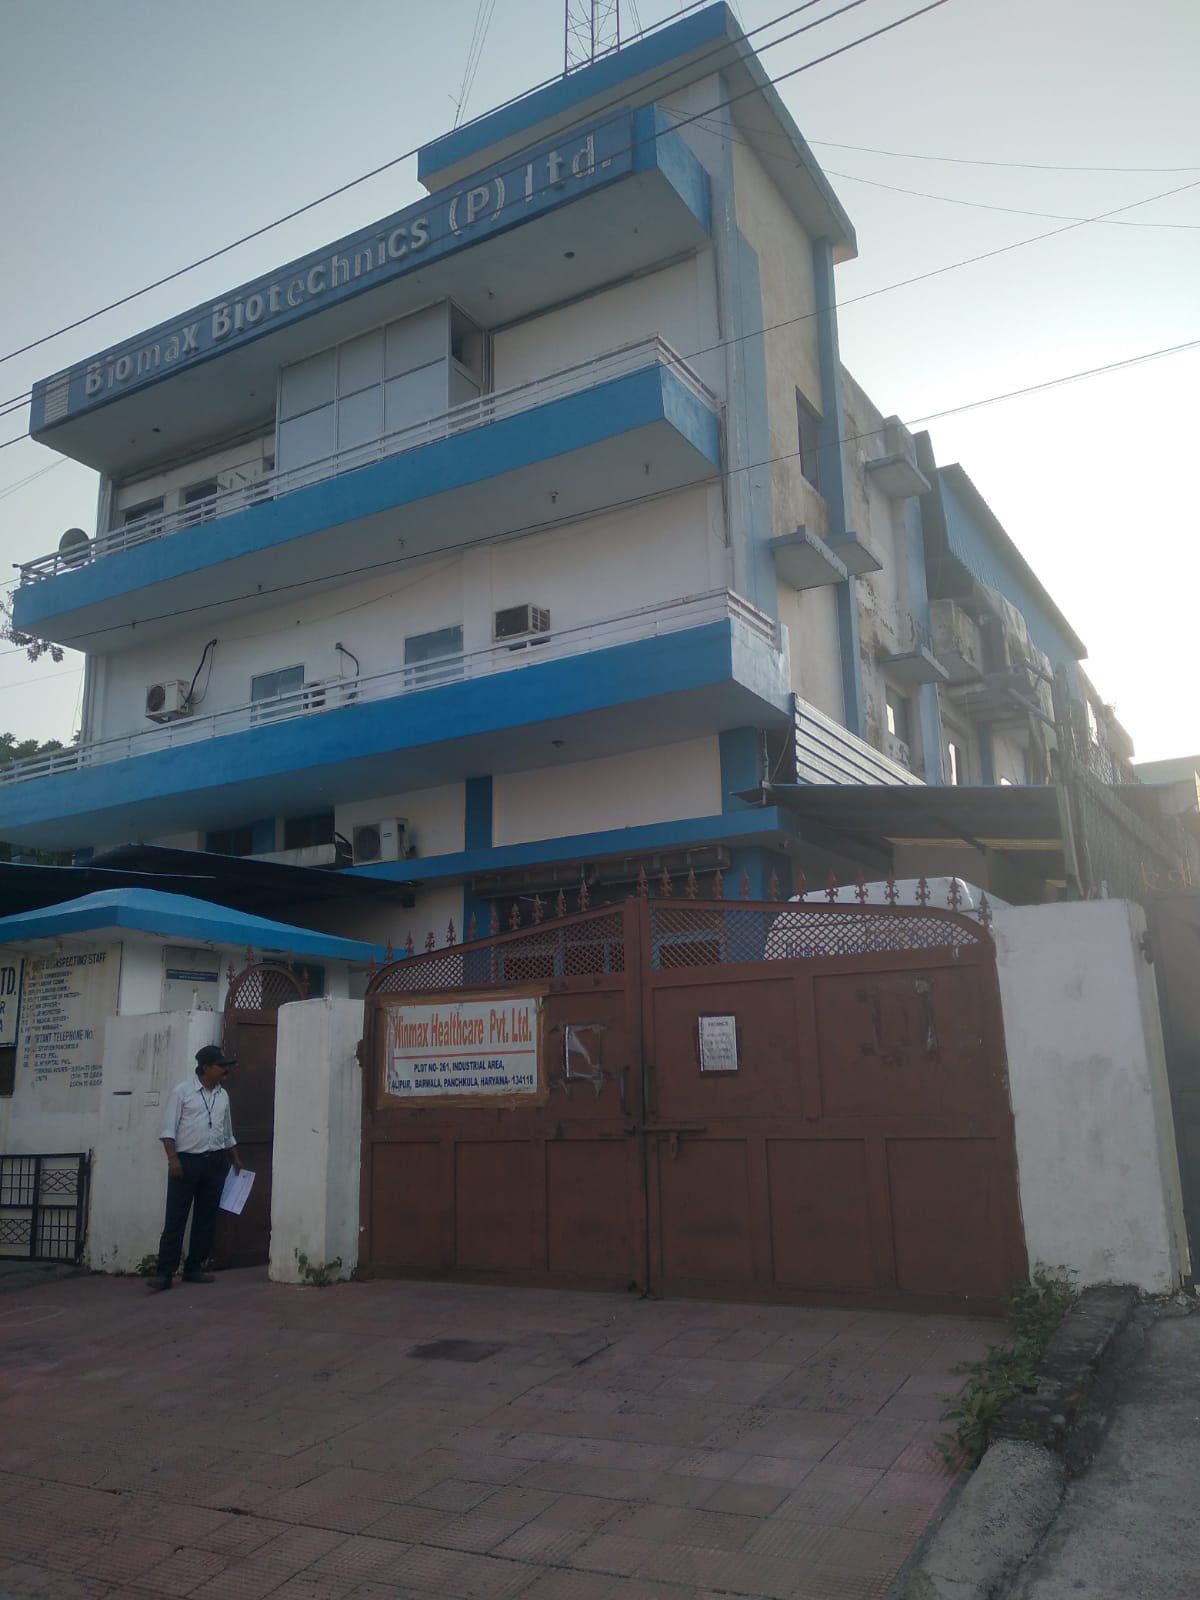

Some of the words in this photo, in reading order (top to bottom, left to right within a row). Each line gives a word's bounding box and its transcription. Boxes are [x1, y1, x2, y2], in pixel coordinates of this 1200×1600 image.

[85, 323, 200, 396] Biomax
[211, 217, 430, 340] Biotechnics
[448, 176, 505, 236] (P)
[88, 952, 107, 965] STAFF
[0, 966, 17, 996] TD.
[431, 1011, 484, 1048] Healthcare
[489, 1008, 509, 1044] Pvt.
[511, 1006, 532, 1043] Ltd.
[414, 1063, 428, 1073] PLOT
[452, 1060, 487, 1072] INDUSTRIAL
[487, 1059, 505, 1071] AREA,
[415, 1078, 443, 1089] BARWALA,
[443, 1076, 480, 1088] PANCHKULA,
